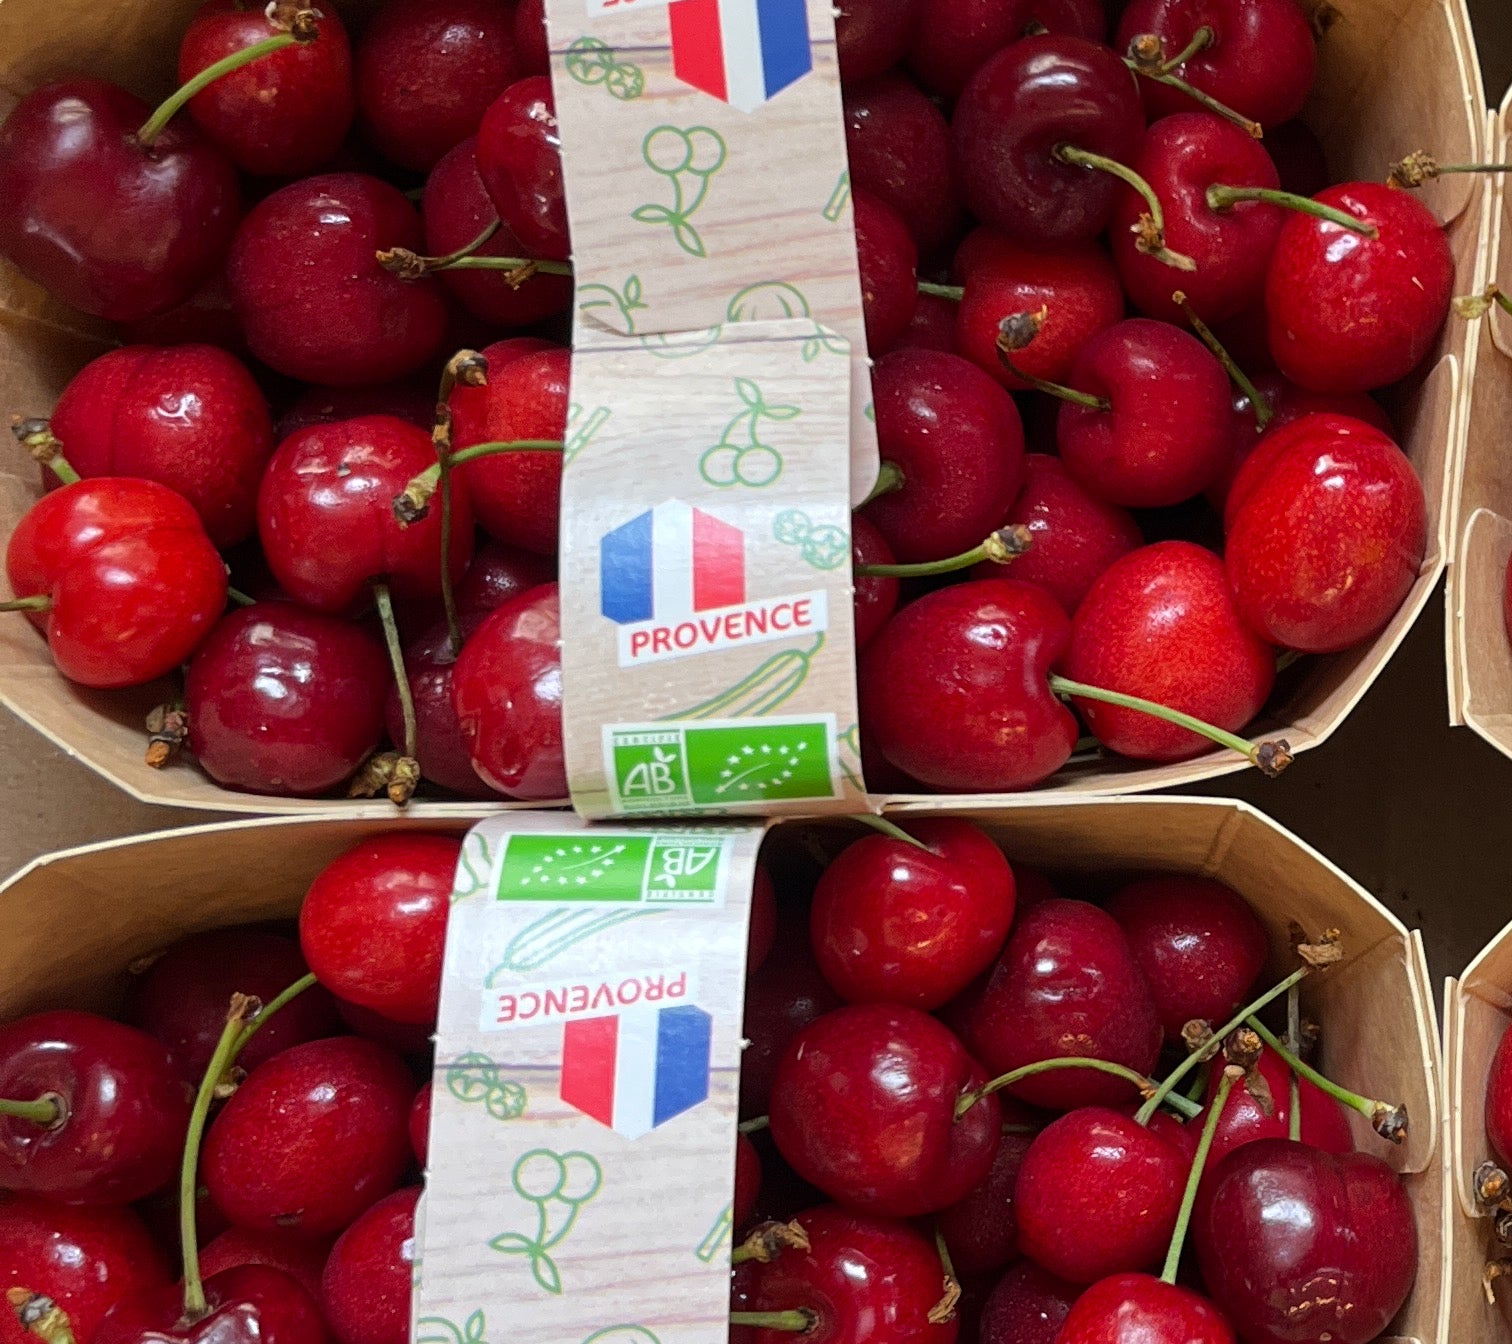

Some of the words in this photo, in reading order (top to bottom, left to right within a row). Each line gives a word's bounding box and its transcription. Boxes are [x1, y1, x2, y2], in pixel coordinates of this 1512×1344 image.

[630, 599, 812, 657] PROVENCE
[623, 762, 676, 796] AB
[663, 847, 717, 876] AB
[496, 971, 687, 1023] PROVENCE
